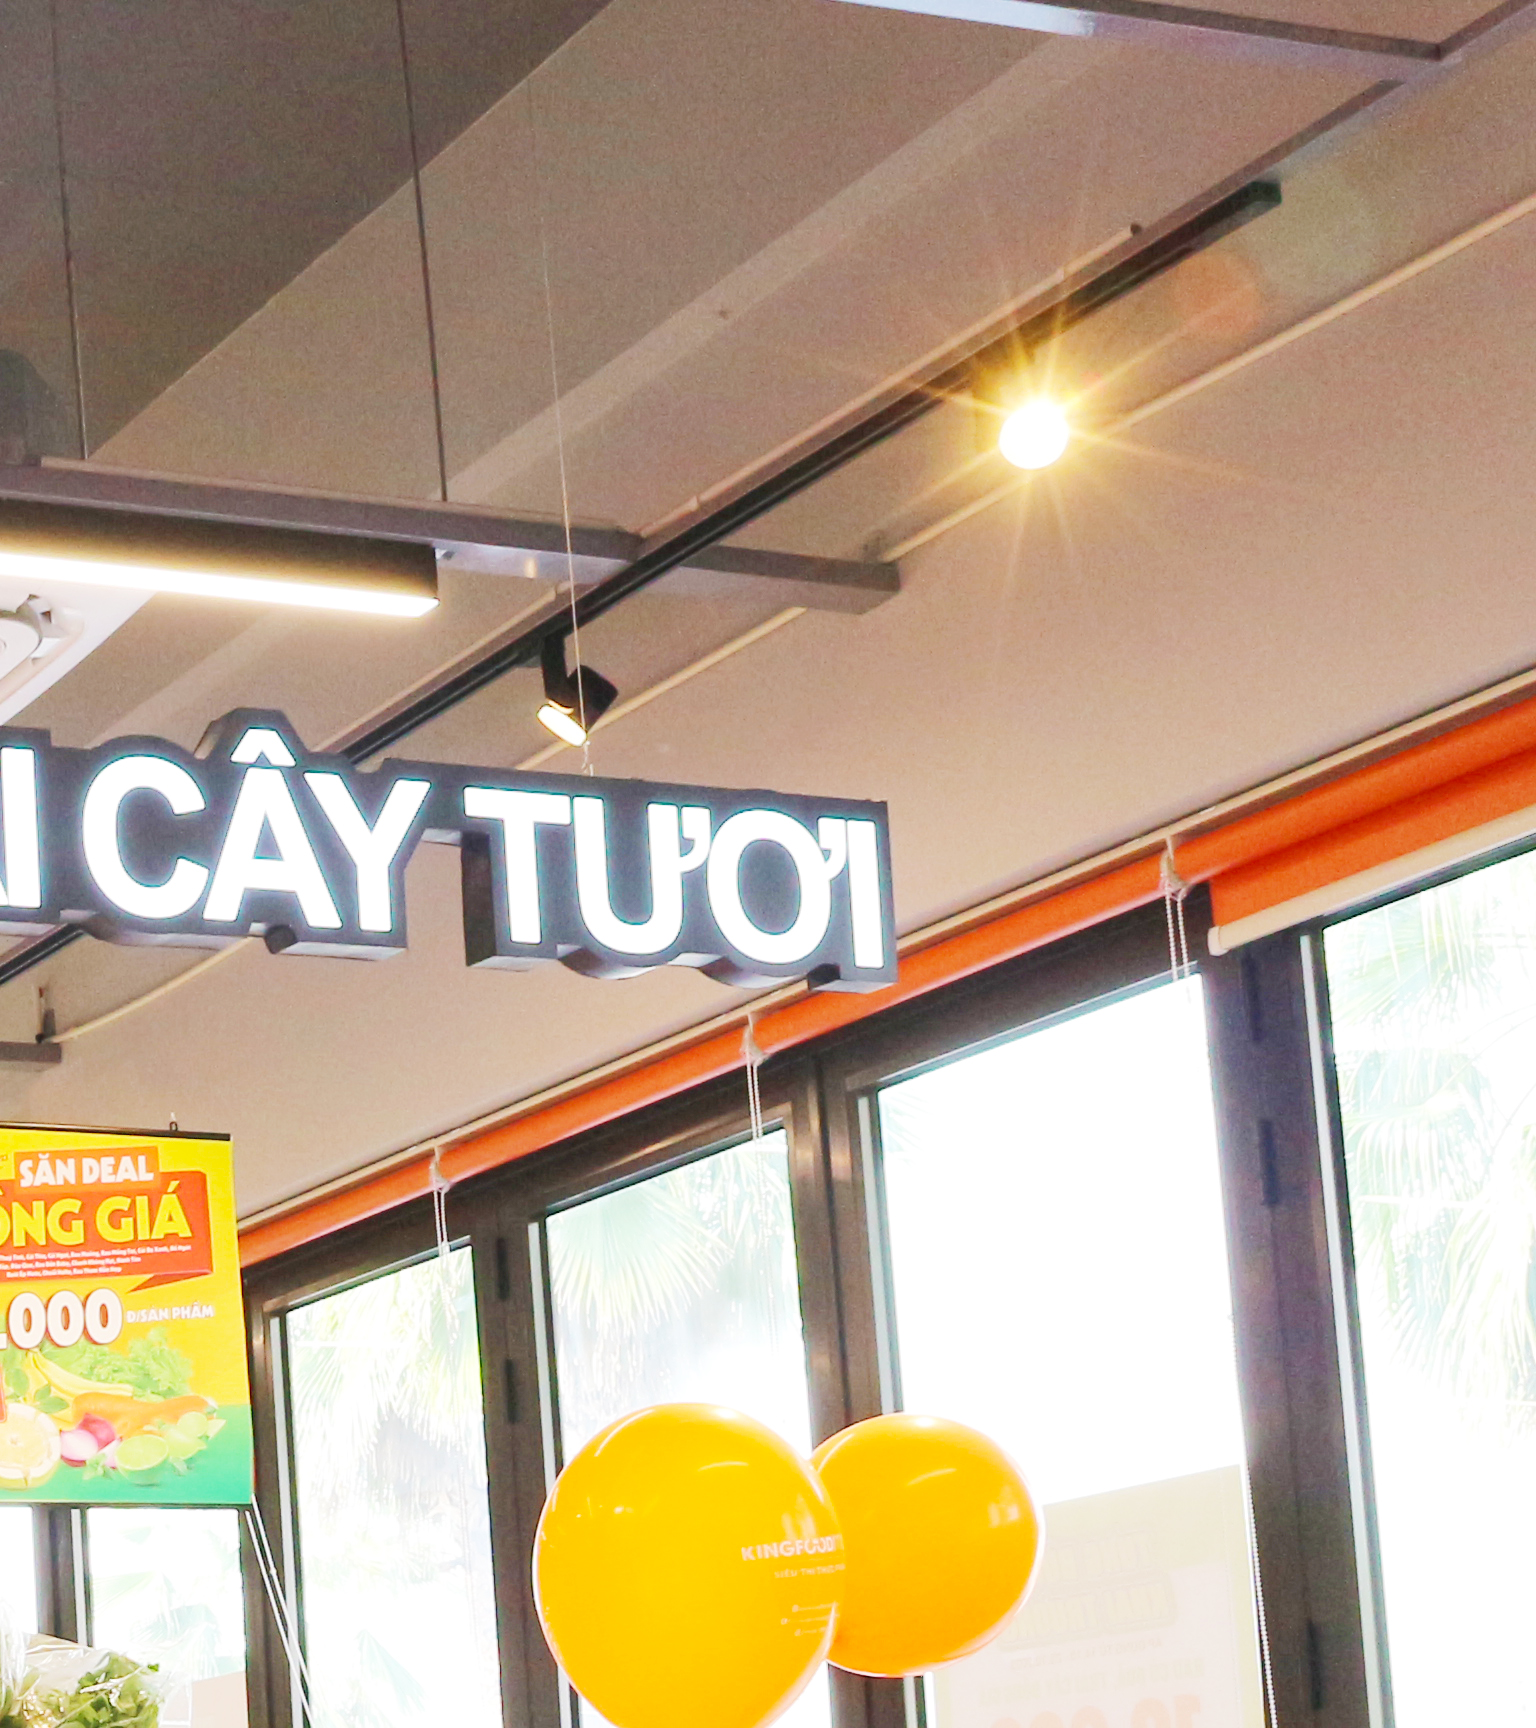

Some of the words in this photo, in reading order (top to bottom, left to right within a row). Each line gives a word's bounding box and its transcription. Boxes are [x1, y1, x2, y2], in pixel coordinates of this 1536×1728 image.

[81, 726, 429, 935] CÂY
[465, 788, 893, 976] TƯƠI
[19, 1153, 77, 1188] SĂN
[85, 1154, 154, 1185] DEAL
[96, 1180, 193, 1243] GIÁ
